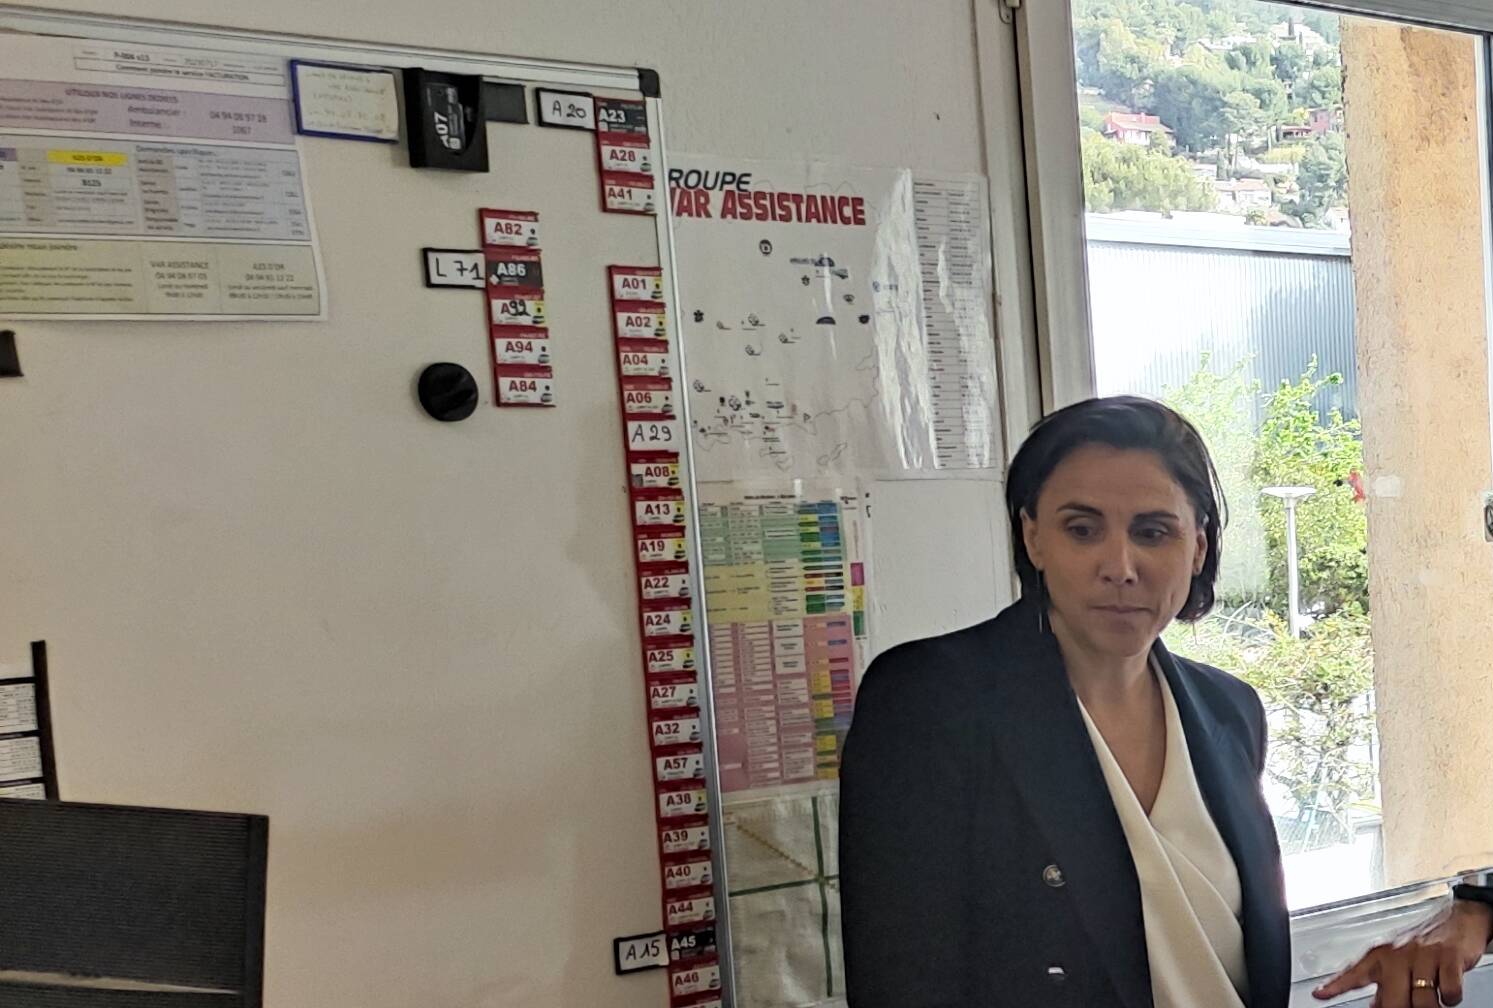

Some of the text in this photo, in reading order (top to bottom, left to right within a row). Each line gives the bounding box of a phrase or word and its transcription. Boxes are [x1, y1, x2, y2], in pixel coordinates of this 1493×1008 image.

[599, 107, 625, 123] A23
[609, 149, 636, 162] A28
[608, 187, 633, 201] A41
[720, 188, 866, 226] ASSISTANCE
[494, 221, 523, 236] A82
[497, 262, 526, 277] A86
[622, 277, 647, 290] A01
[625, 315, 651, 328] A02
[505, 340, 533, 353] A94
[623, 354, 648, 366] A04
[509, 379, 537, 393] A84
[626, 392, 652, 404] A06
[644, 466, 670, 478] A08
[645, 504, 670, 516] A13
[640, 541, 665, 552] A19
[644, 577, 669, 590] A22
[645, 614, 671, 626] A24
[648, 650, 674, 663] A25
[652, 686, 676, 698] A27
[655, 723, 680, 736] A32
[664, 757, 688, 771] A57
[666, 793, 692, 807] A38
[663, 830, 688, 843] A39
[666, 865, 691, 879] A40
[669, 901, 693, 915] A44
[671, 935, 696, 950] A45
